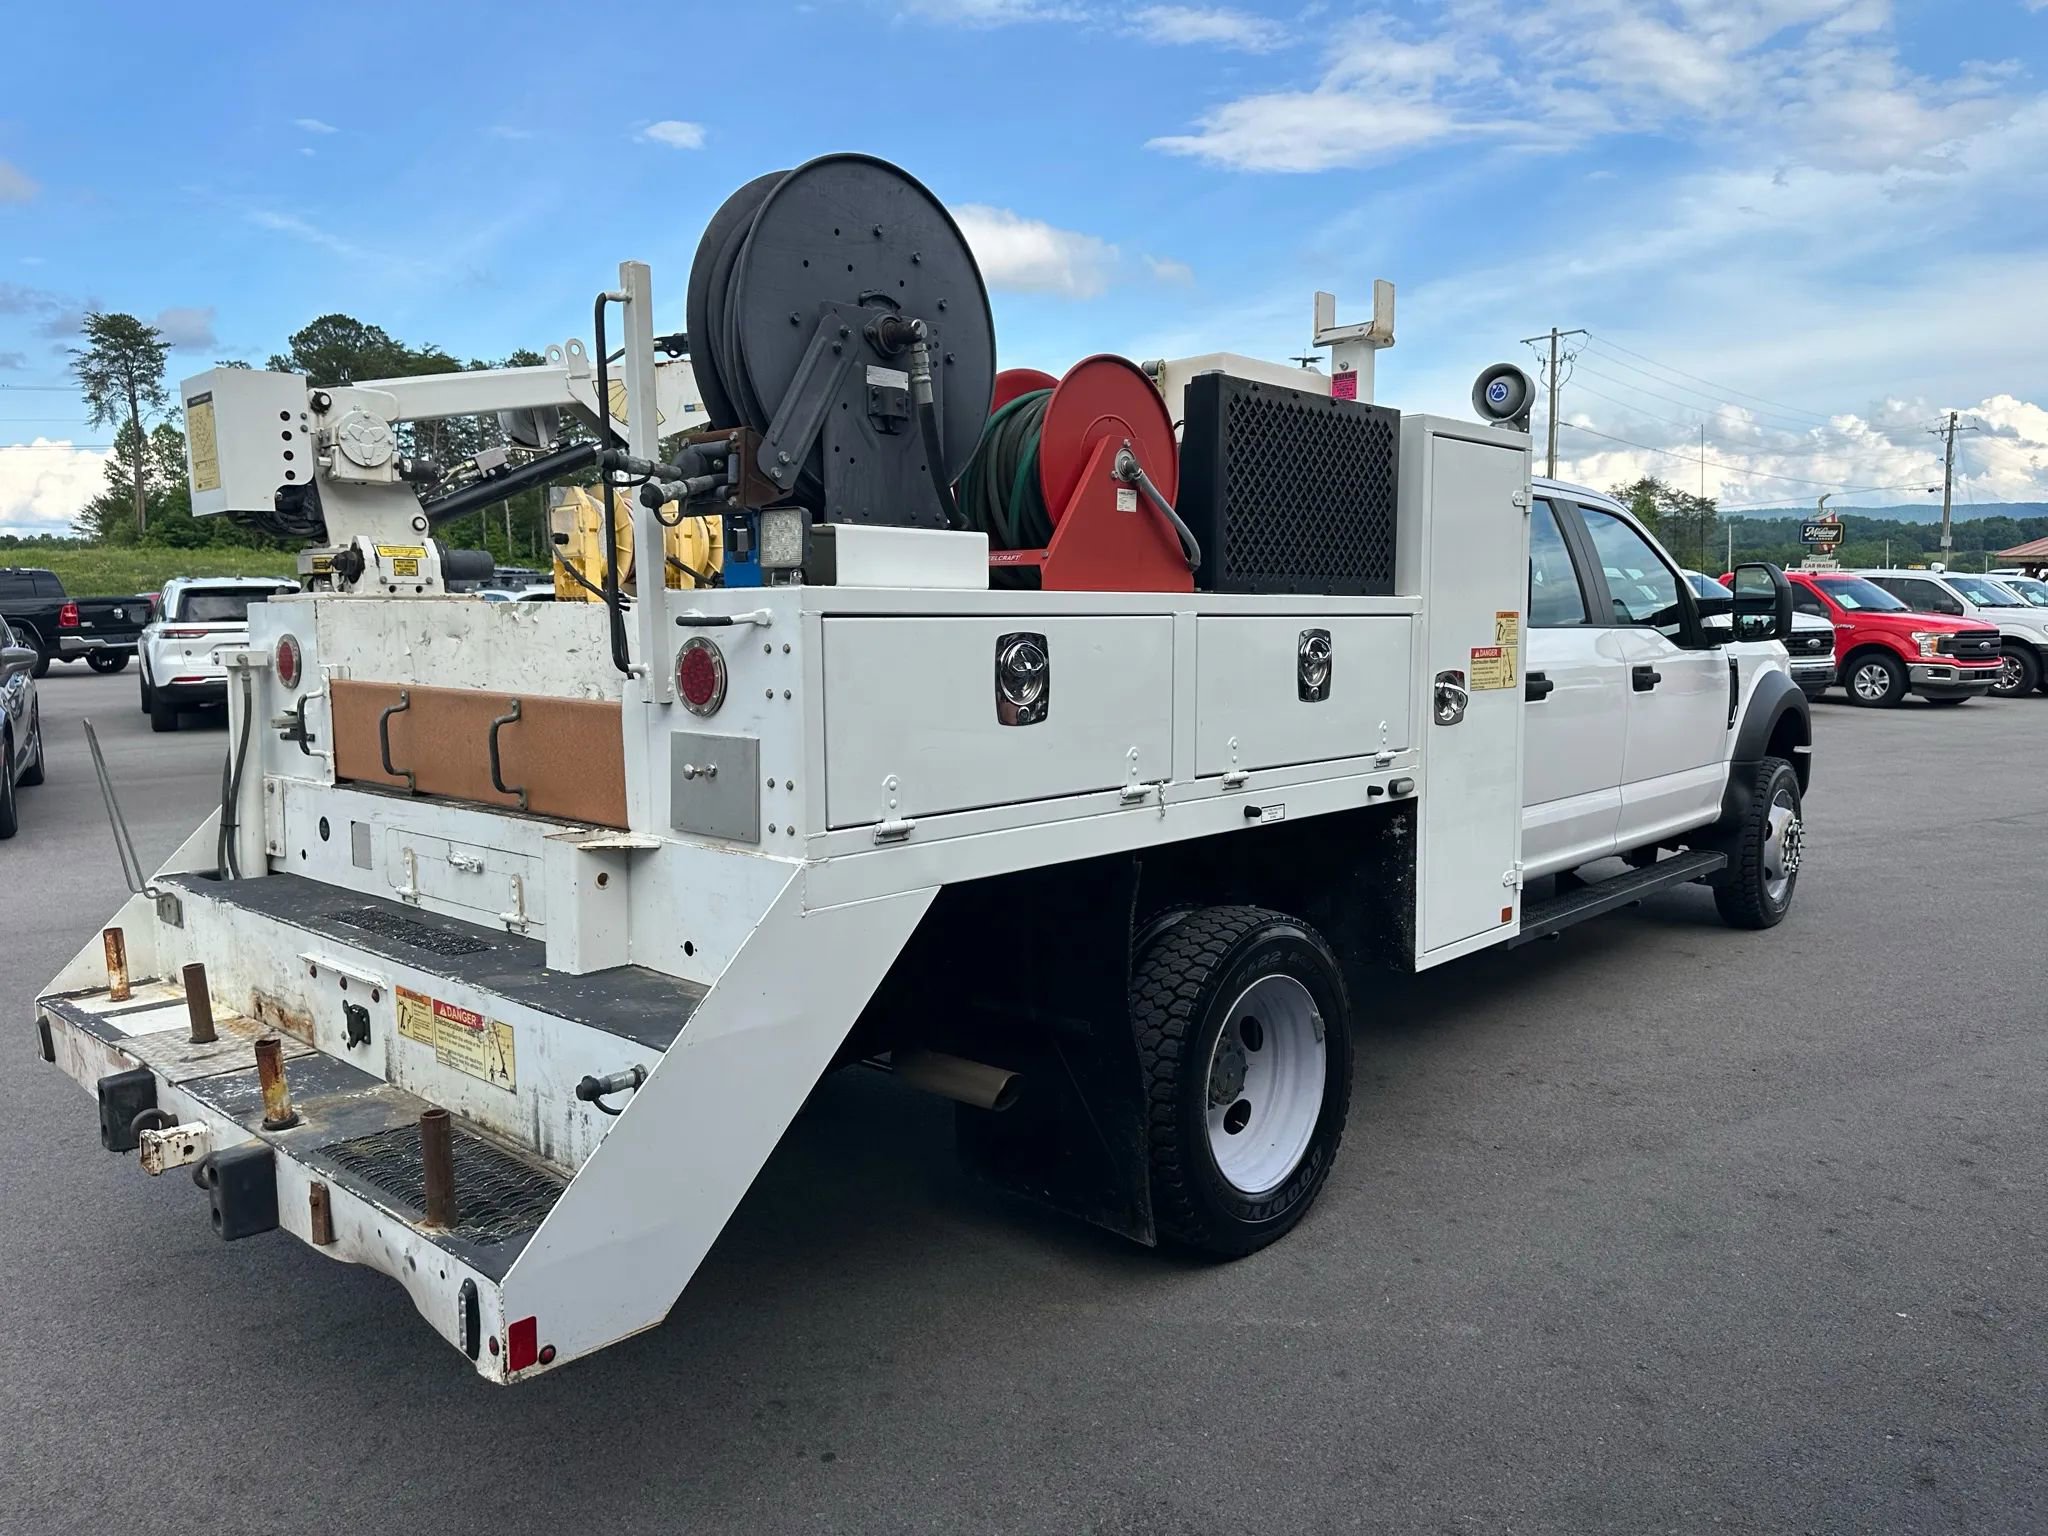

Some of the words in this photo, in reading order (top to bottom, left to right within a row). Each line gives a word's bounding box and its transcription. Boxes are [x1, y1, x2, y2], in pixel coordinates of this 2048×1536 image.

[1804, 526, 1838, 537] Midway
[1480, 649, 1498, 657] DANGER
[446, 1006, 477, 1026] DANGER
